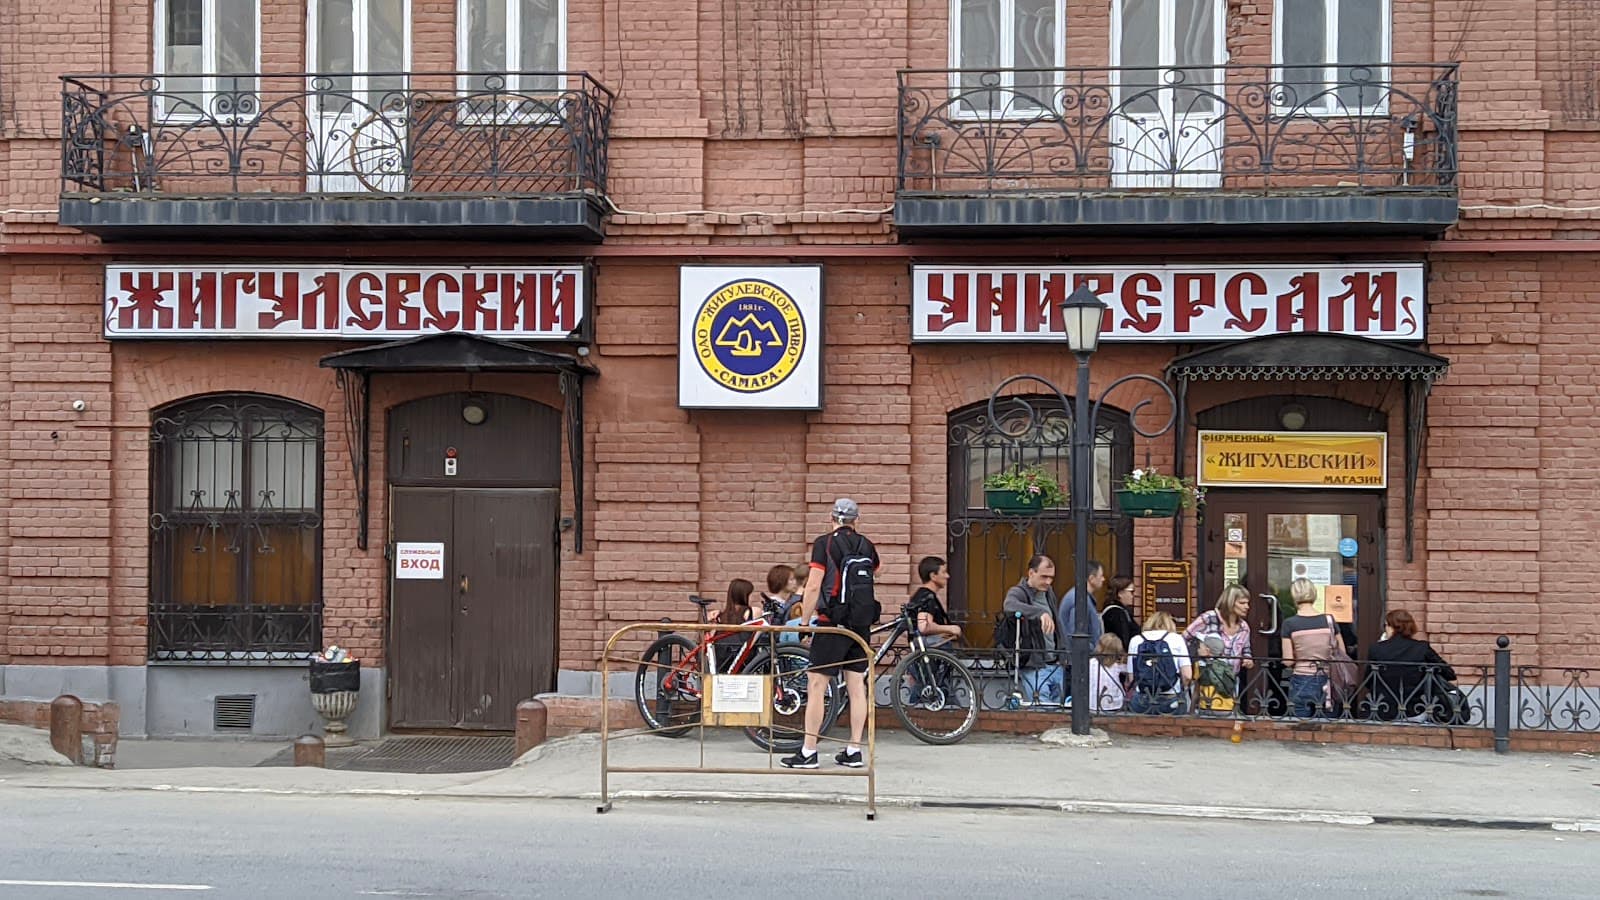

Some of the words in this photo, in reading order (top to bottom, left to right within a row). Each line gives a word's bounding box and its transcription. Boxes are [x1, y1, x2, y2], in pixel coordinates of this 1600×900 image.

[118, 270, 576, 331] ЖИГУЛЕВСКИЙ
[1201, 433, 1275, 443] ФИРМЕННЫЙ
[1323, 475, 1382, 484] МАГАЗИН
[400, 558, 441, 571] ВХОД
